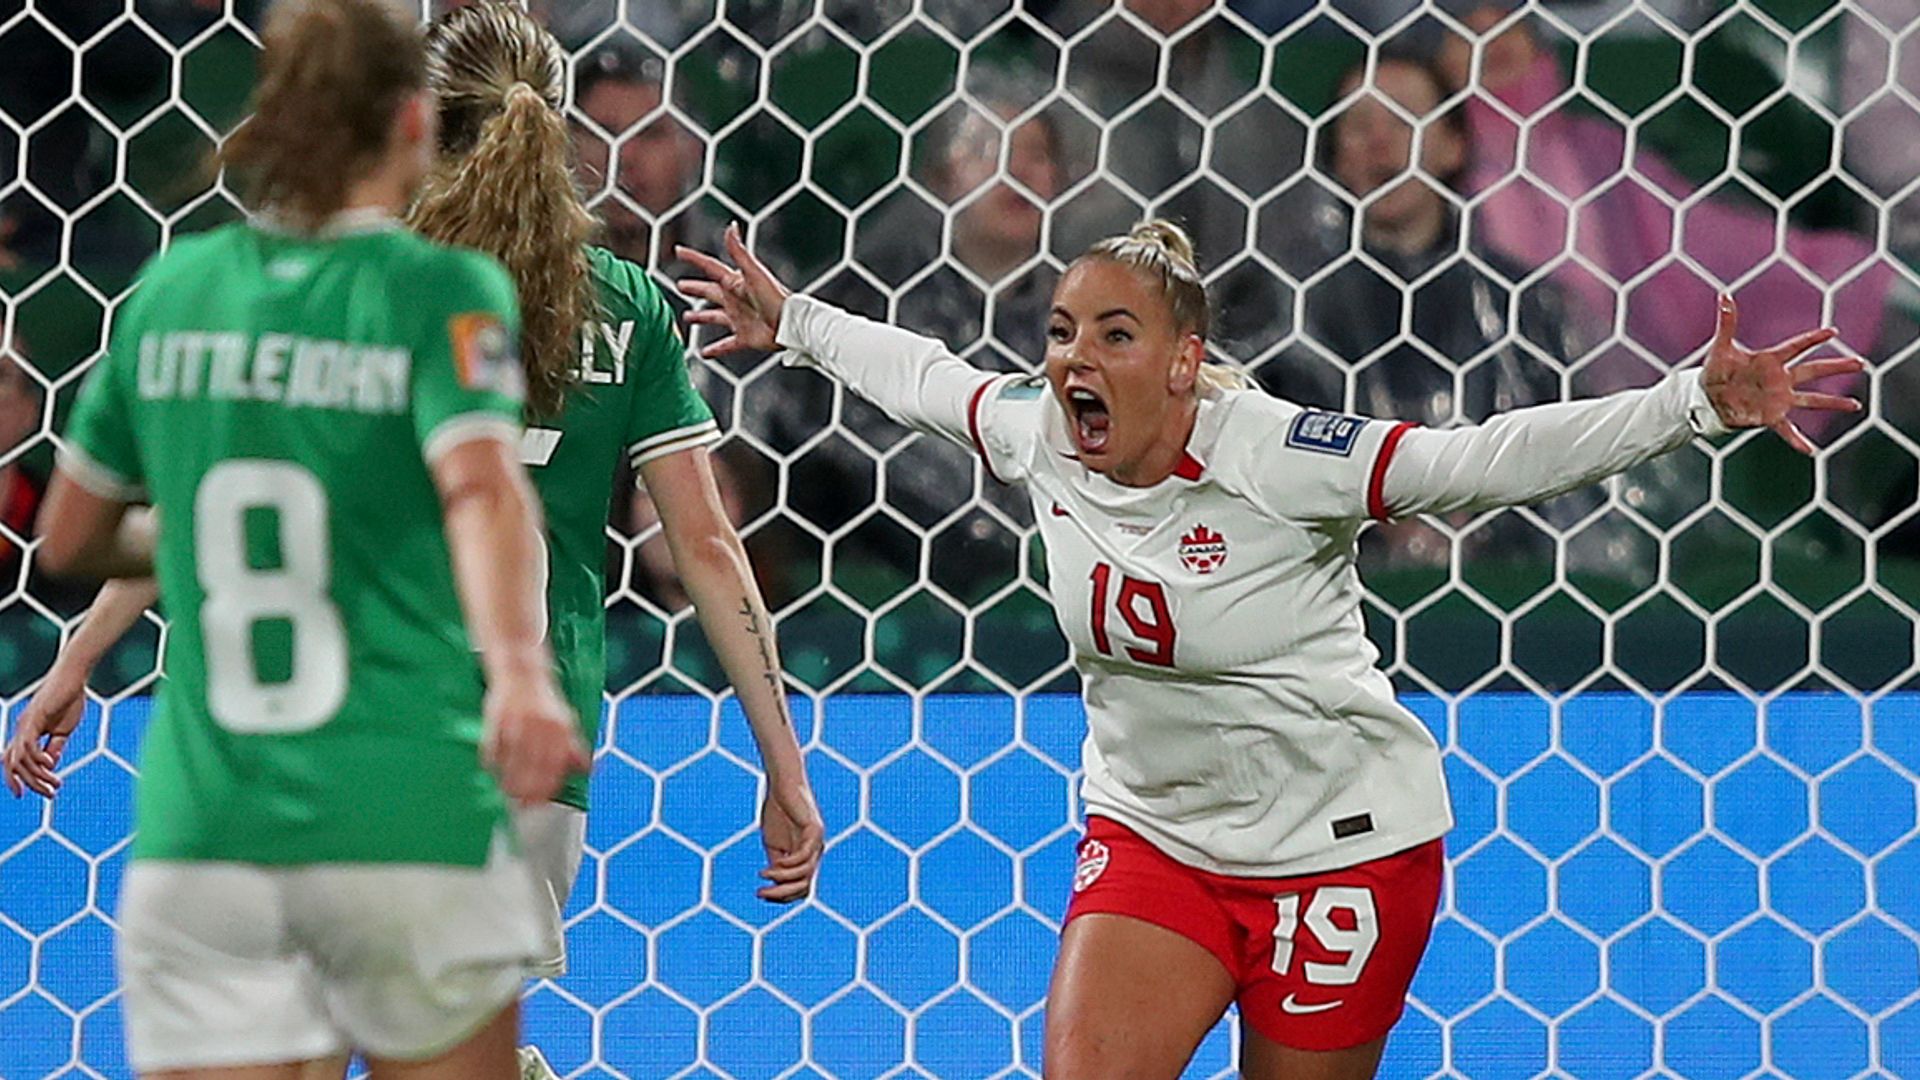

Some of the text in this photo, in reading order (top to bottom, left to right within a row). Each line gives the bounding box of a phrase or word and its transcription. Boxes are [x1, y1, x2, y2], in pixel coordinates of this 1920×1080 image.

[137, 331, 412, 415] LITTLEJOHN
[194, 458, 349, 734] 8
[1178, 543, 1227, 555] CANADA
[1090, 562, 1177, 668] 19
[1272, 886, 1379, 985] 19
